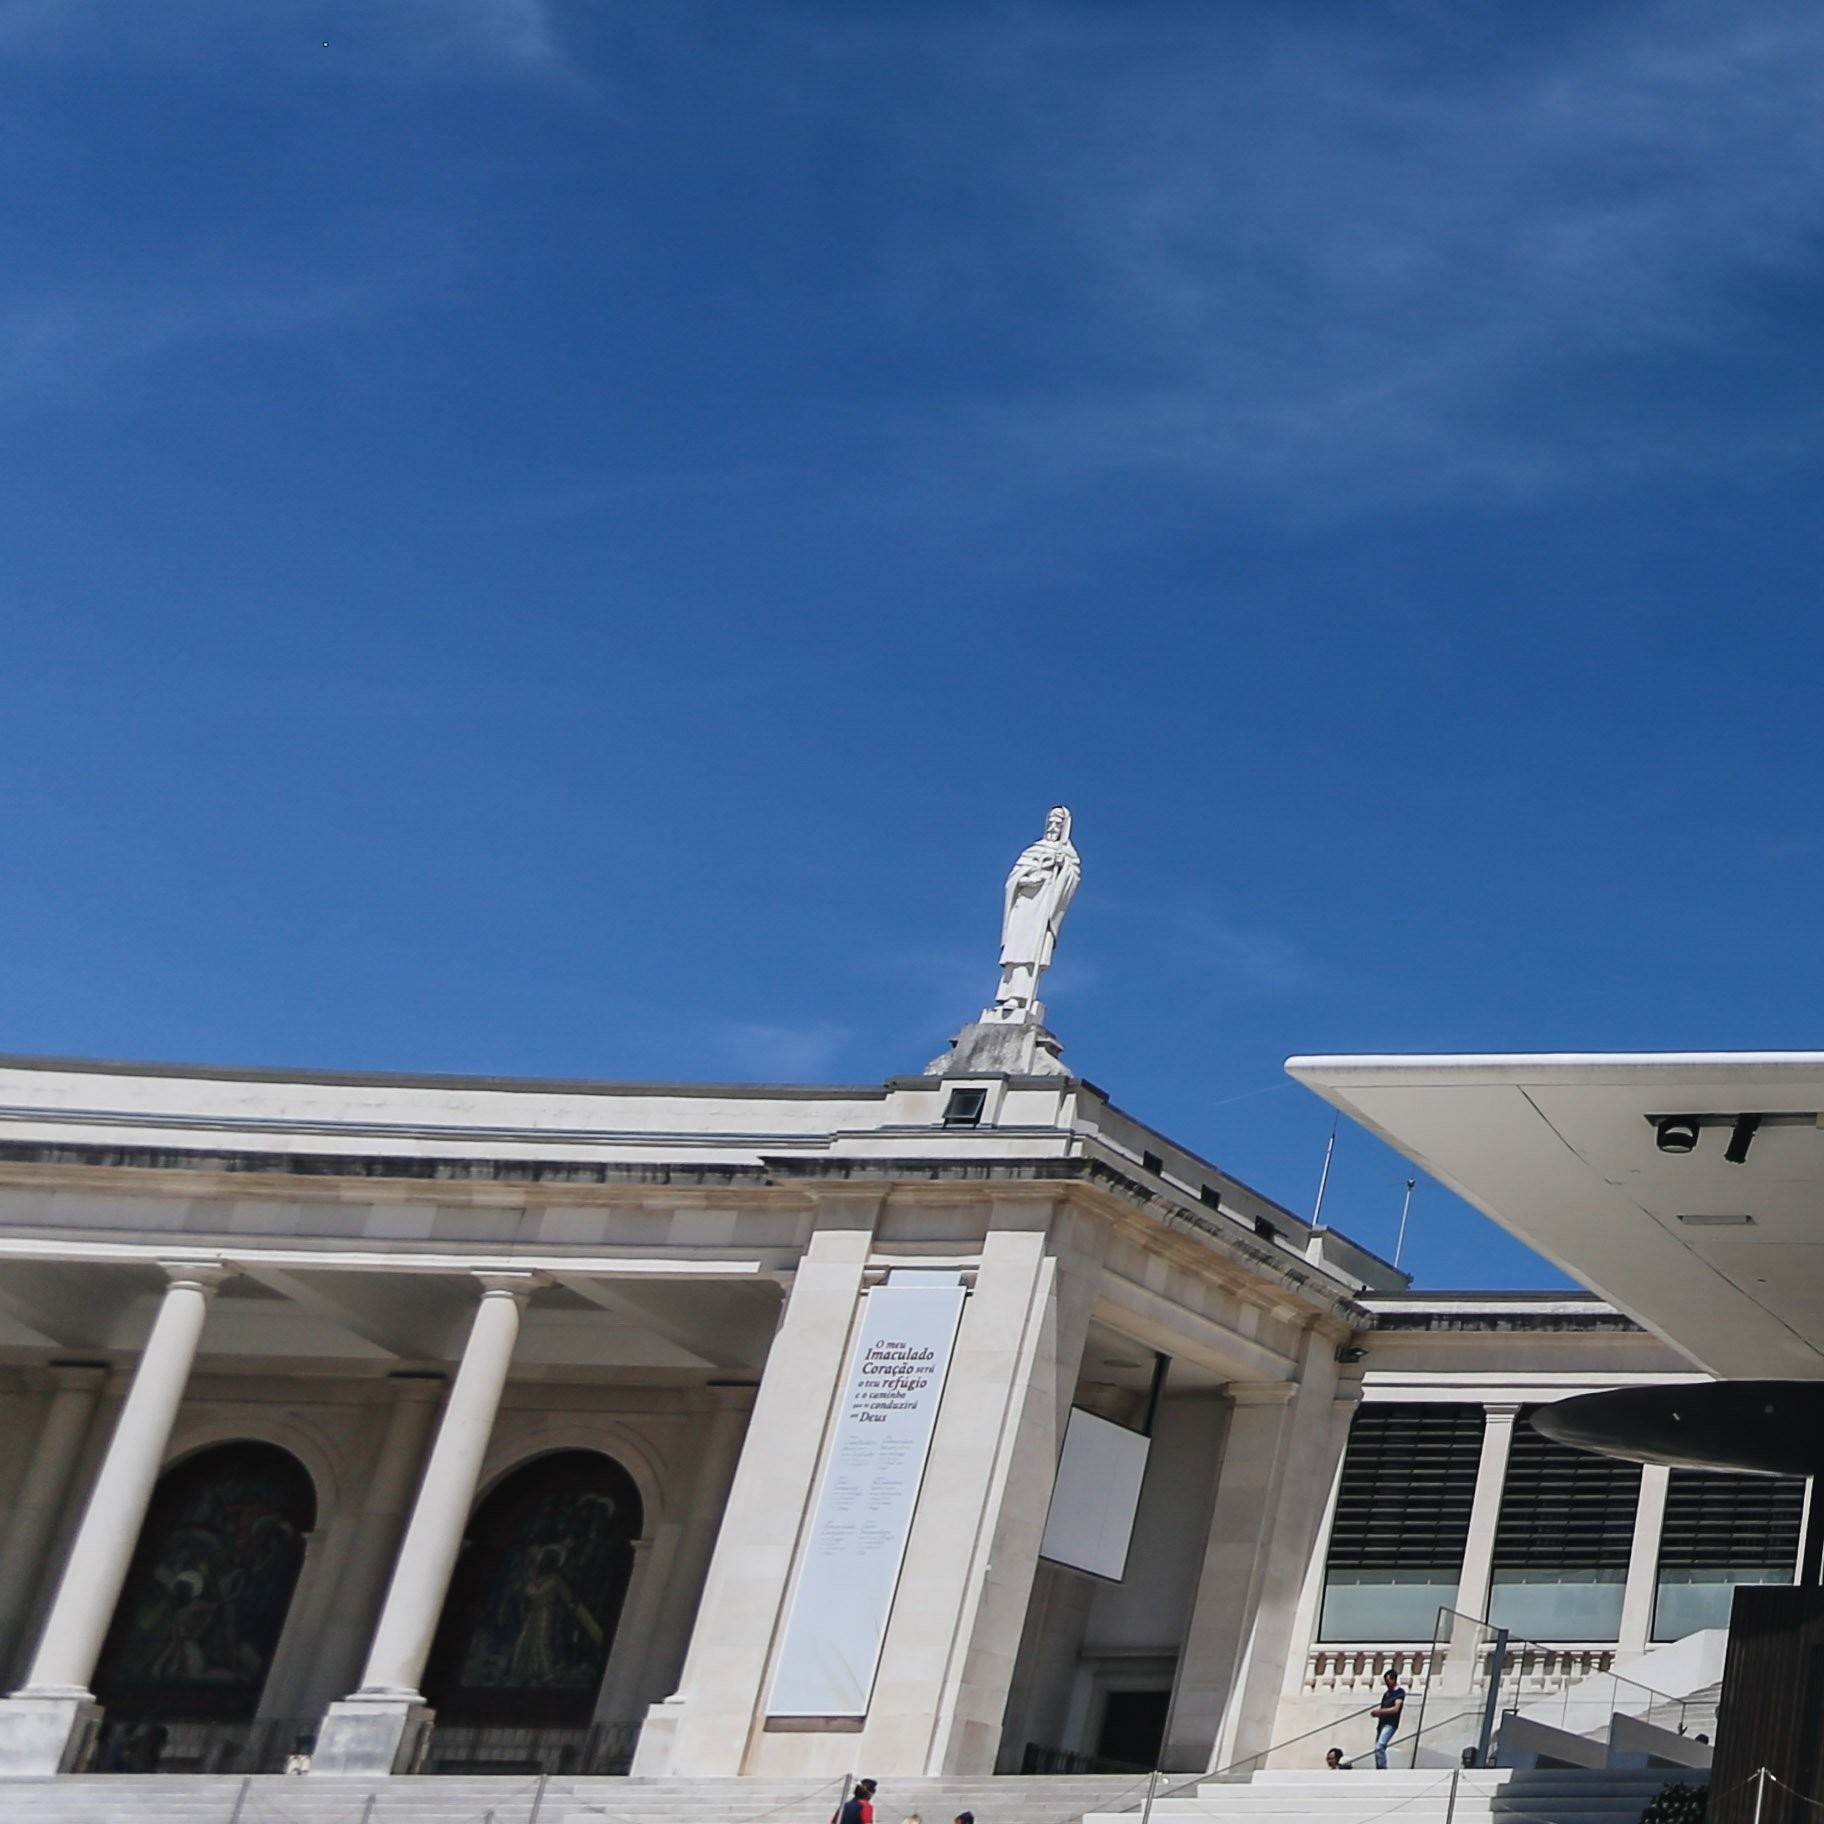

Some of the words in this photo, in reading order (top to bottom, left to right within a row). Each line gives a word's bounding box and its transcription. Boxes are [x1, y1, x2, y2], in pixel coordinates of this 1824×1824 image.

[876, 1339, 885, 1348] O
[886, 1341, 907, 1349] meu
[864, 1347, 935, 1361] Imaculado
[862, 1362, 914, 1377] Coração
[881, 1376, 928, 1392] refúgio
[859, 1411, 888, 1422] Deus
